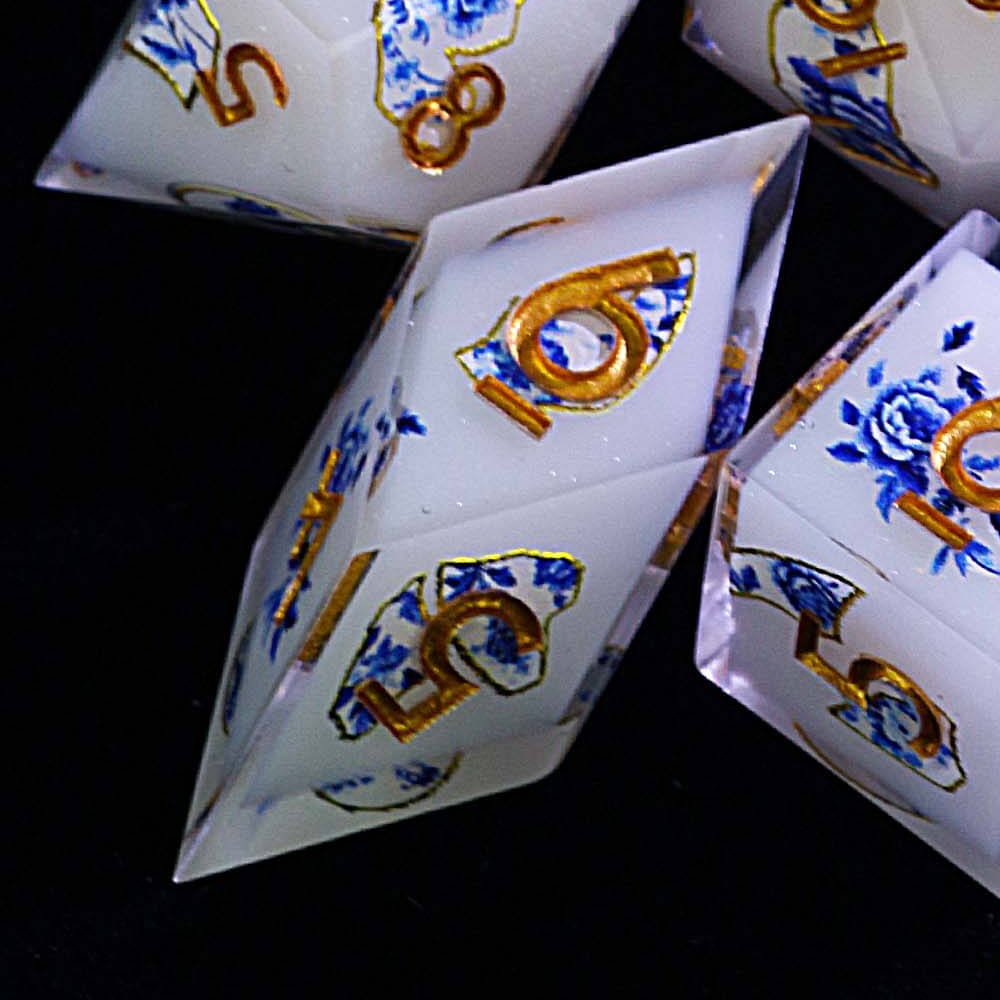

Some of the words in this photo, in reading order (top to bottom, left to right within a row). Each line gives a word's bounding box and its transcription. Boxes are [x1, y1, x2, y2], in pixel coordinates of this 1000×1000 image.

[195, 42, 290, 127] 5
[399, 62, 506, 176] 8
[354, 587, 543, 743] 5
[794, 609, 943, 759] 5
